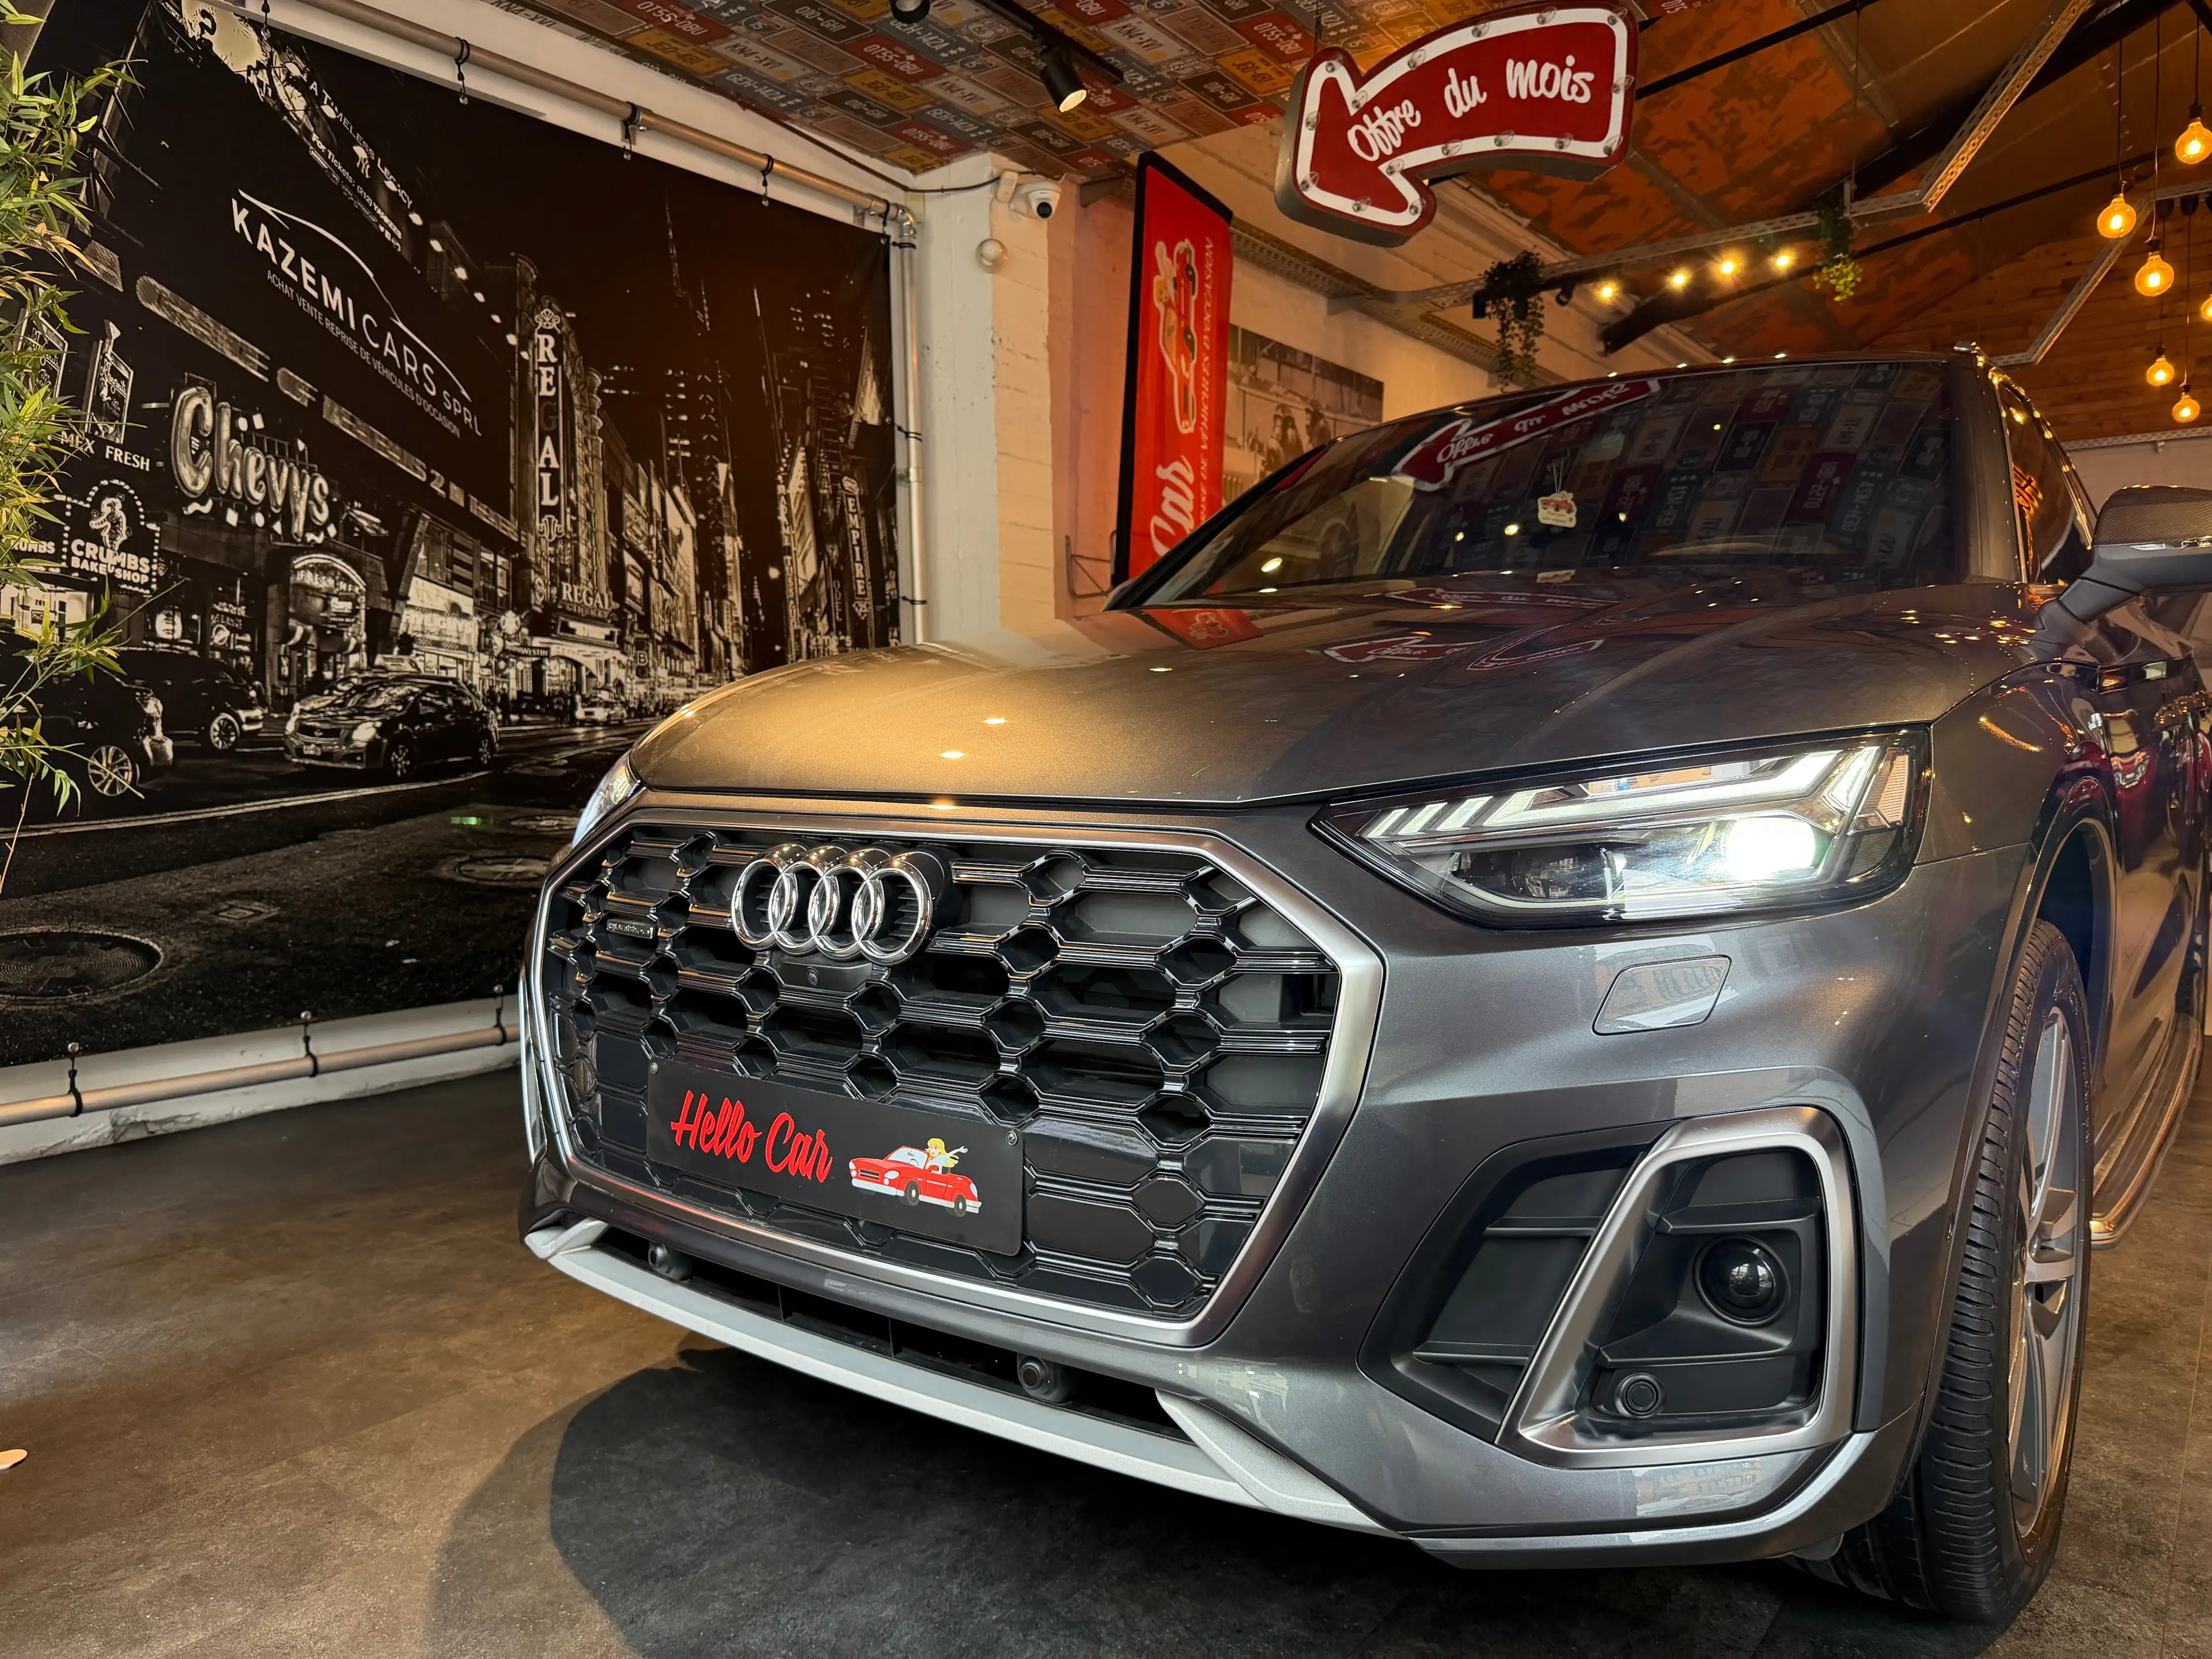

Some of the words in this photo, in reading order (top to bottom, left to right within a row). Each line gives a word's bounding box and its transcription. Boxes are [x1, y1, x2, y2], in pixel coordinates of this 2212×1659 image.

[1346, 99, 1422, 162] Offre
[1444, 67, 1487, 119] du
[267, 270, 296, 301] ACHAT
[296, 294, 324, 327] VENTE
[324, 317, 359, 354] REPRISE
[359, 344, 372, 366] DE
[442, 389, 482, 437] SPRL
[536, 333, 560, 507] REGAL
[105, 445, 150, 472] FRESH
[171, 386, 329, 541] Chevys
[5, 539, 56, 554] RUMBS
[70, 539, 150, 575] CRUMBS
[846, 496, 867, 597] EMPIRE
[115, 569, 149, 585] SHOP
[560, 581, 613, 612] REGAL
[521, 646, 547, 657] WESTIN
[671, 1090, 762, 1164] Hello
[766, 1112, 834, 1184] Car
